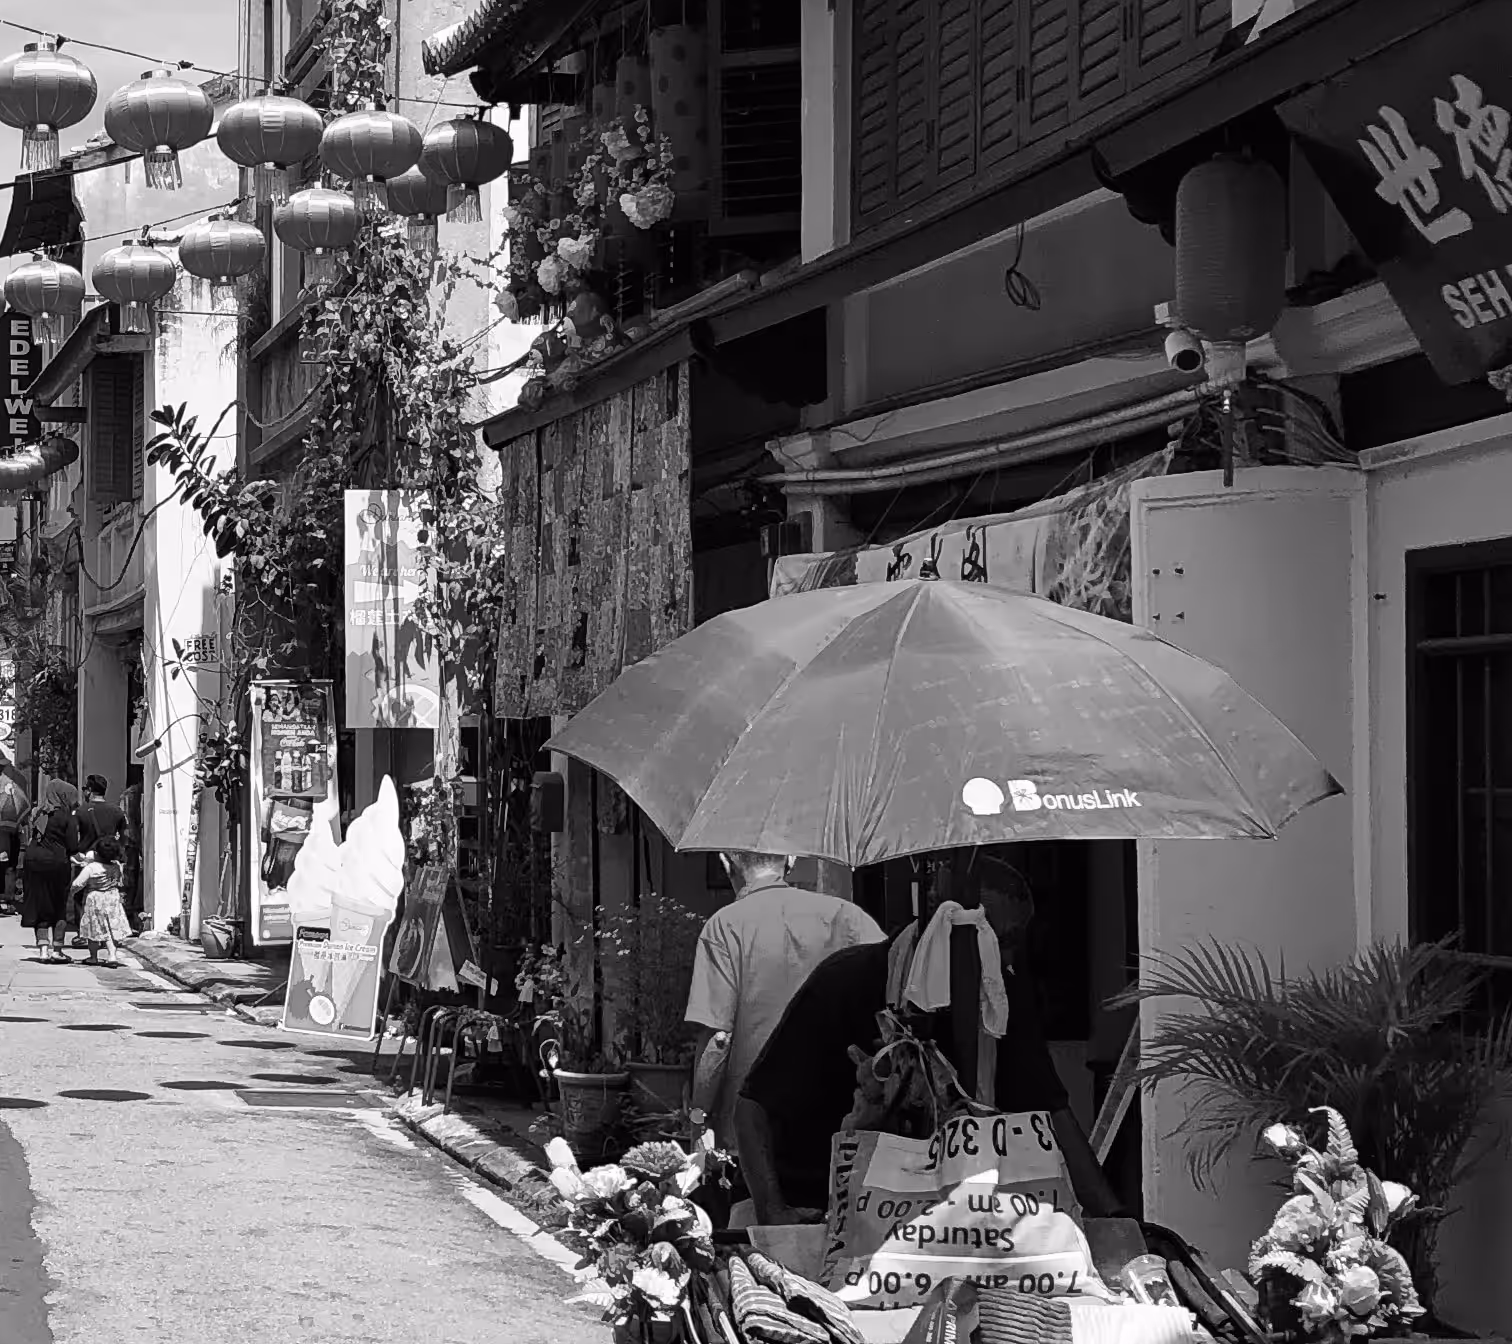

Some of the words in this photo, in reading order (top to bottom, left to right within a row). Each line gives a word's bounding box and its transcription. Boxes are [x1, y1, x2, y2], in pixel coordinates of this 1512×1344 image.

[1441, 269, 1512, 329] SEH
[399, 565, 422, 577] her
[186, 638, 216, 652] FREE
[1007, 779, 1143, 812] BonusLink
[876, 1198, 938, 1219] 2.00
[968, 1193, 1003, 1215] am
[885, 1223, 1016, 1253] Saturday
[869, 1270, 932, 1296] 6.00
[1019, 1269, 1083, 1295] 7.00
